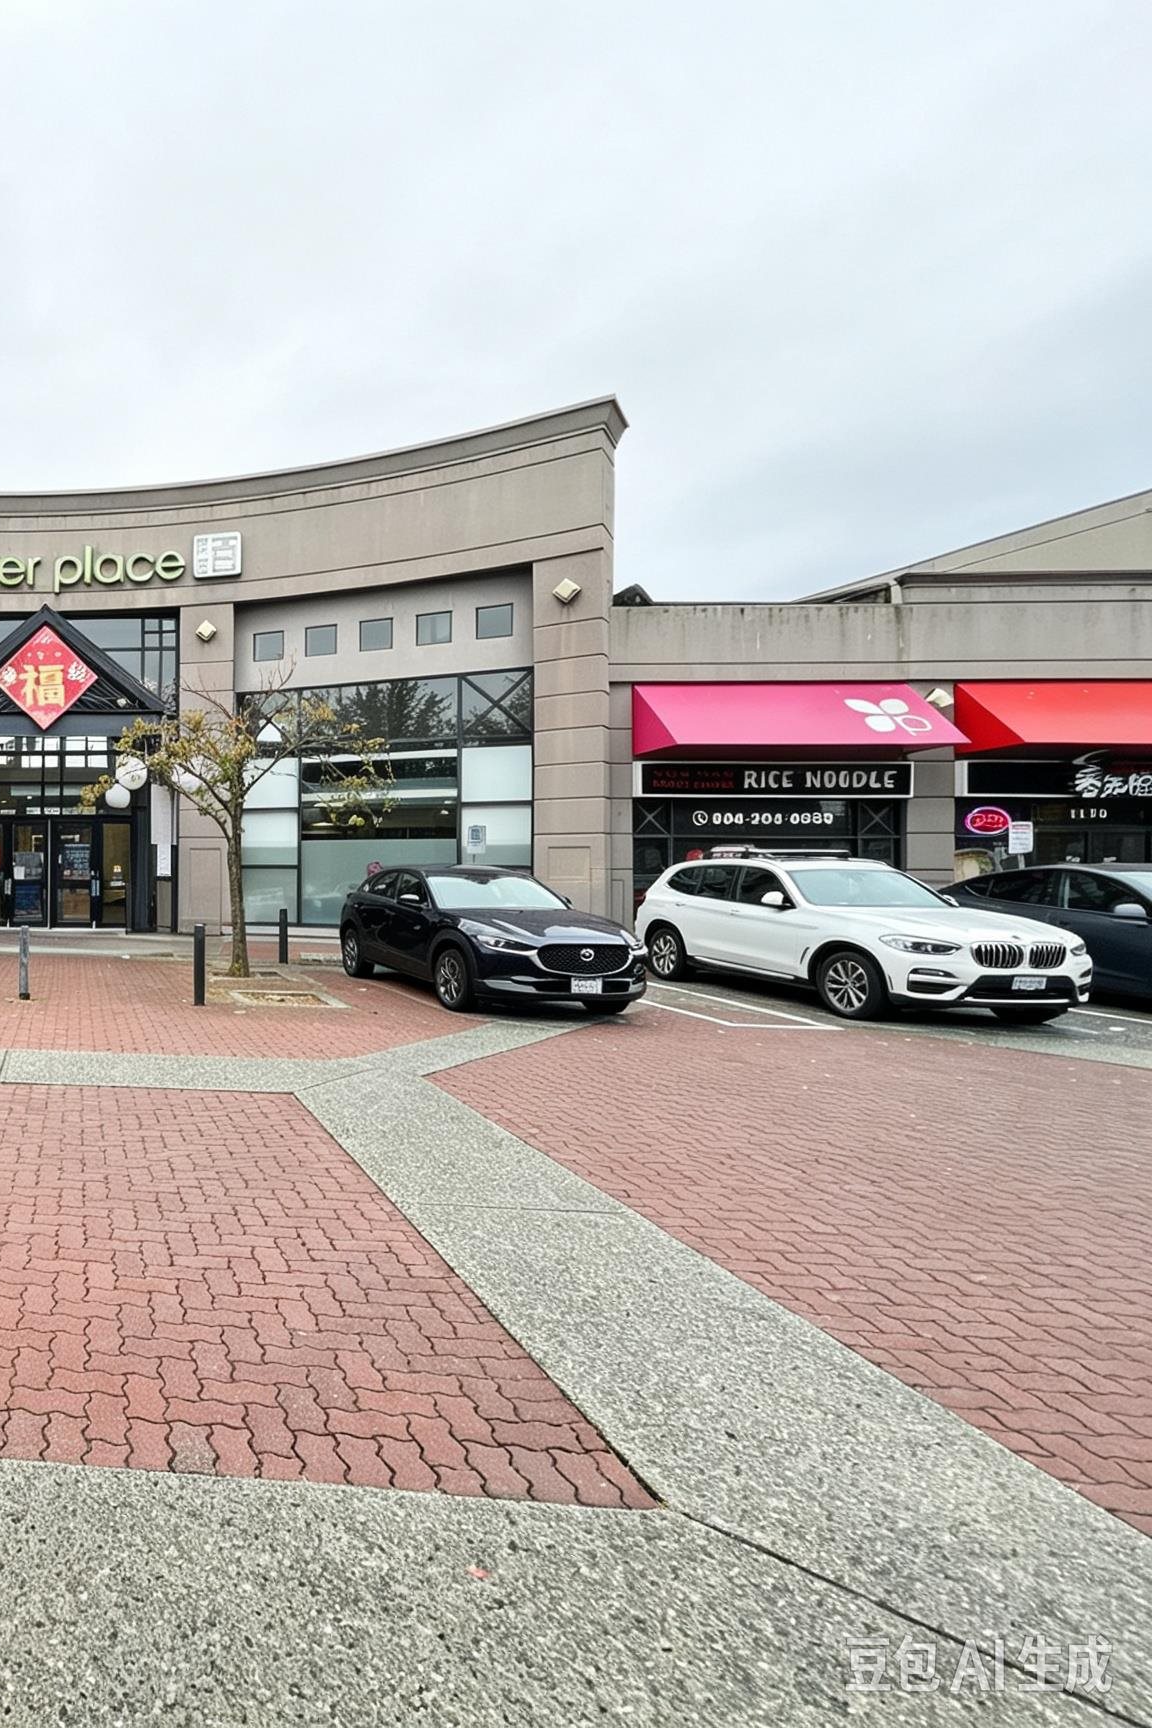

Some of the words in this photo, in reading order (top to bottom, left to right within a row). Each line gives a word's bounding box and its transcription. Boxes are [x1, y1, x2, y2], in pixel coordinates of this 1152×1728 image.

[54, 545, 186, 594] place
[18, 664, 65, 708] 福
[743, 770, 794, 789] RICE
[805, 770, 898, 789] NOODLE
